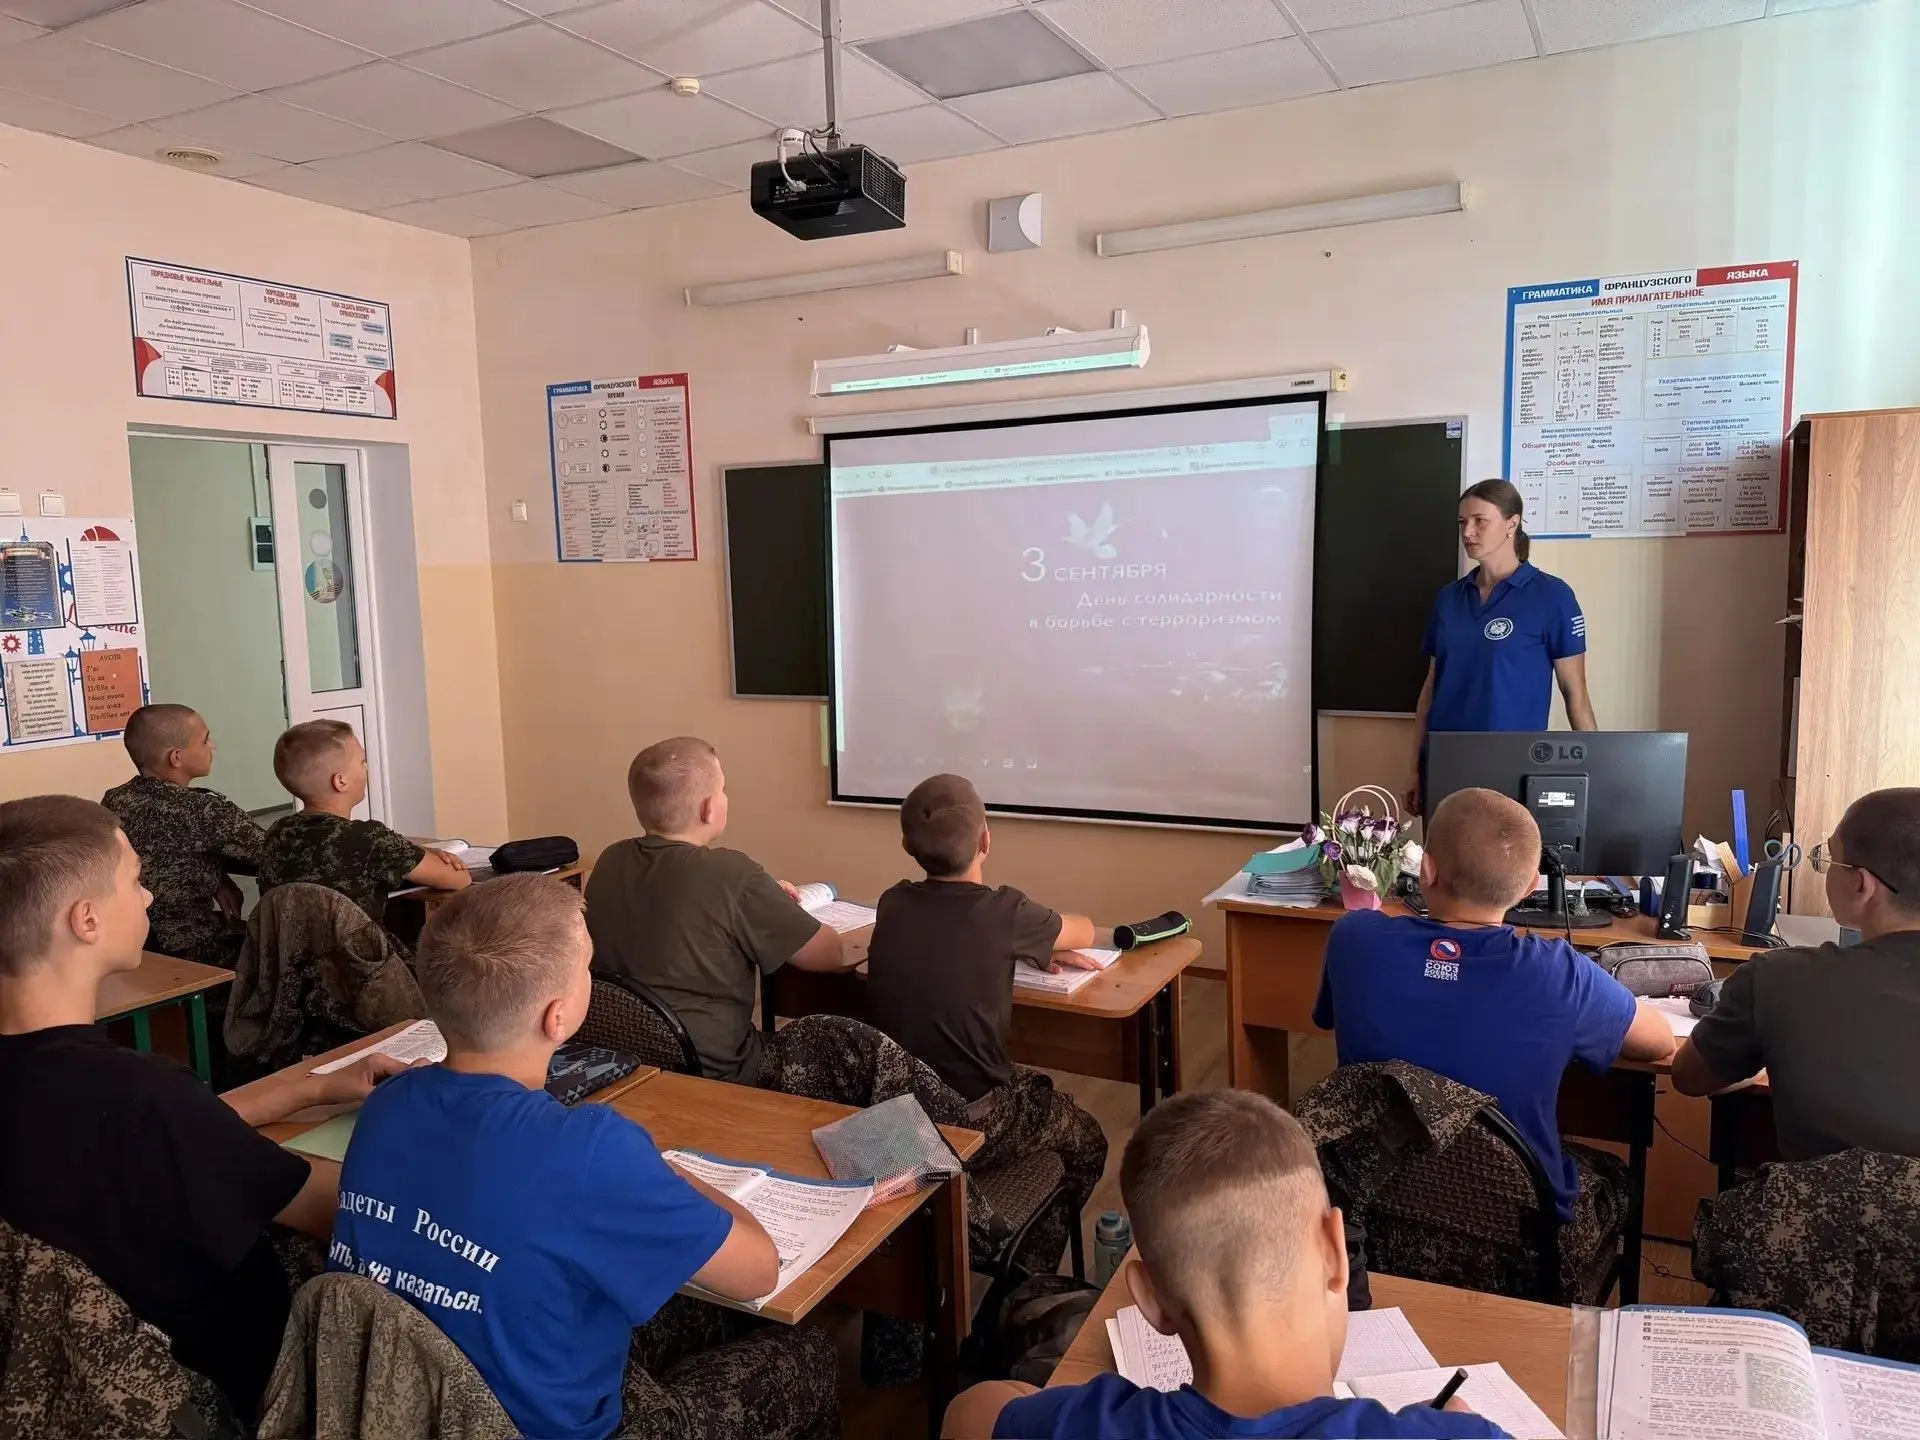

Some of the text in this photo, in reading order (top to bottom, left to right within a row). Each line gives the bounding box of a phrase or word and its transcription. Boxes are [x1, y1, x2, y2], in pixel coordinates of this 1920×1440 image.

[151, 269, 223, 288] ПОРЯДКОВЫЕ ЧИСЛИТЕЛЬНЫЕ
[1604, 275, 1692, 291] ФРАНЦУЗСКОГО
[1726, 269, 1768, 280] ЯЗЫКА
[1523, 286, 1593, 300] ГРАММАТИКА
[1591, 288, 1704, 307] ИМЯ ПРИЛАГАТЕЛЬНОЕ
[553, 385, 588, 394] ГРАММАТИКА
[594, 380, 636, 390] ФРАНЦУЗСКОГО
[1021, 547, 1167, 582] 3 СЕНТЯБРЯ
[1076, 589, 1282, 608] День солидарности
[1029, 618, 1038, 629] в
[1046, 615, 1114, 632] борьбе
[1137, 614, 1281, 629] терроризмом
[1558, 745, 1583, 760] LG
[1426, 962, 1459, 973] СОЮЗ
[338, 1186, 396, 1223] адеты
[412, 1208, 500, 1273] России
[328, 1234, 355, 1271] ыть,
[395, 1270, 483, 1314] казаться.
